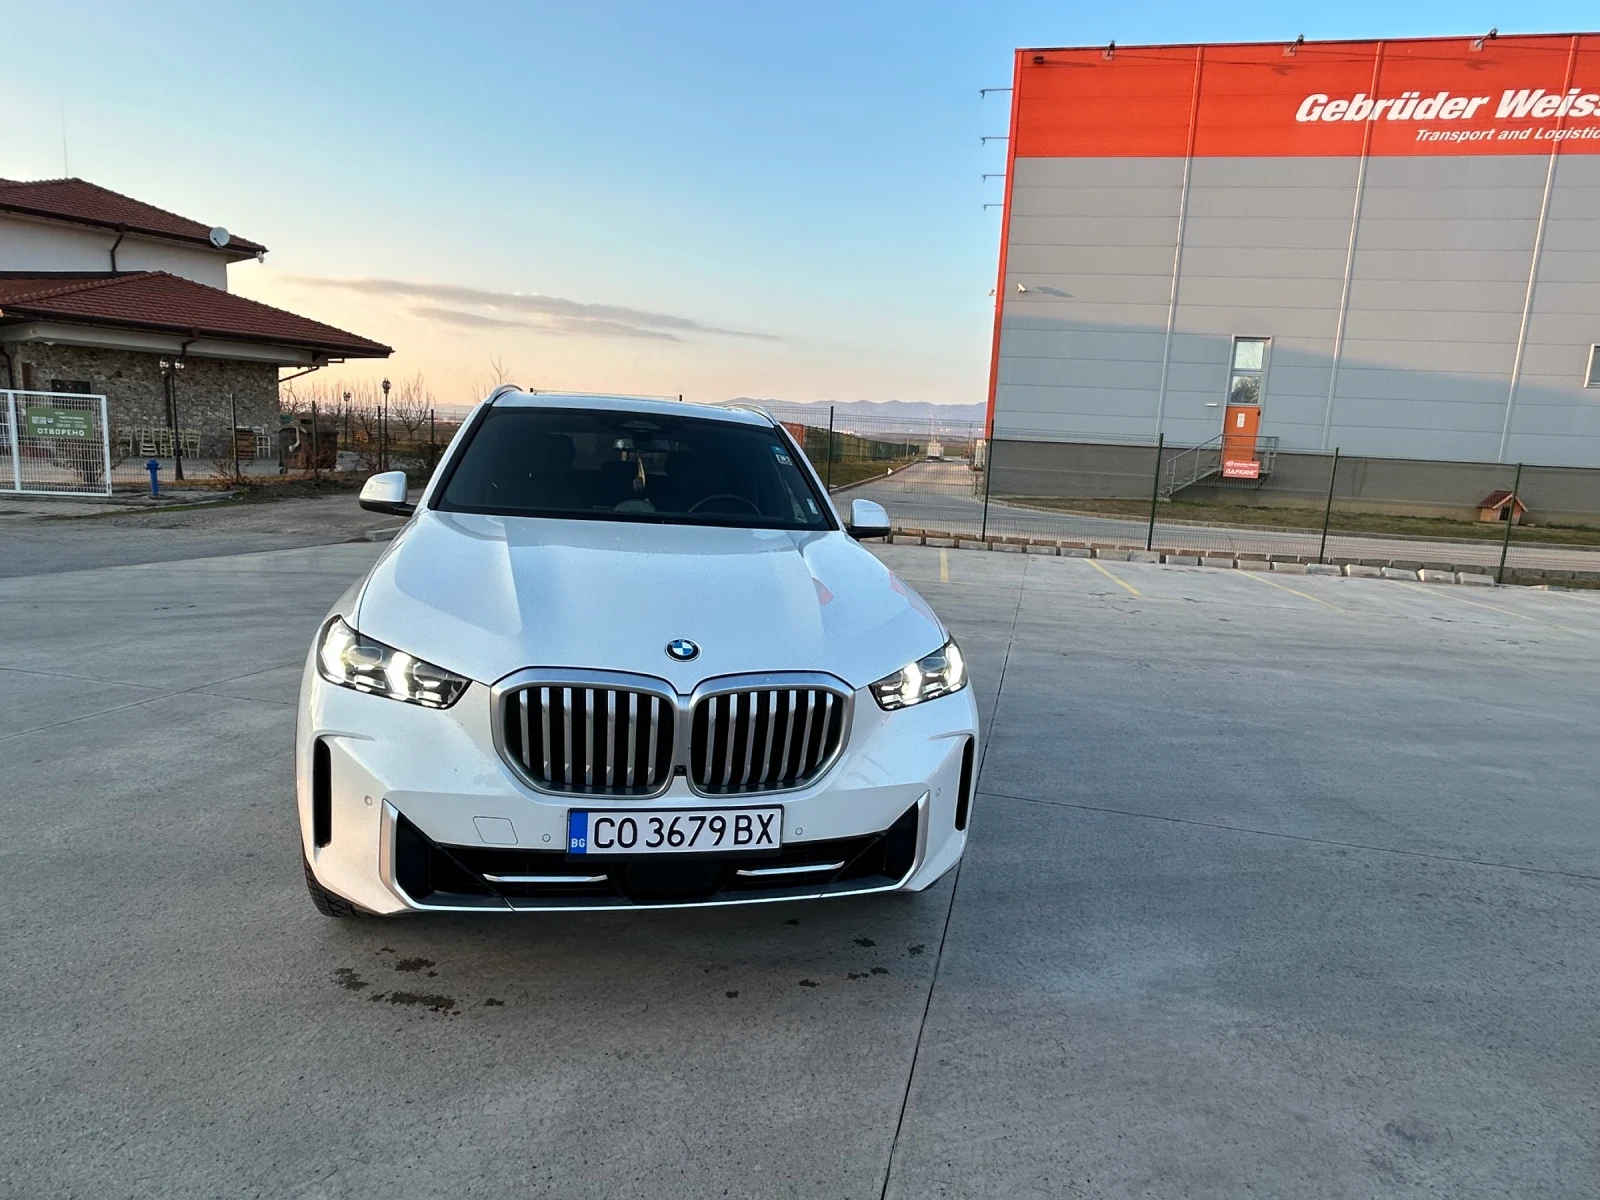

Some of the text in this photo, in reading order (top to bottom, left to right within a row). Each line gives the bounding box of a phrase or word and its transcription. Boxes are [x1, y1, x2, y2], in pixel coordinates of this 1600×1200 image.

[1295, 87, 1600, 122] Gebrüder Weis
[1415, 128, 1495, 142] Transport
[1497, 127, 1533, 140] and
[37, 427, 85, 436] ОТВОРЕНО
[1225, 468, 1257, 476] ПАРКИНГ
[645, 815, 727, 848] 3679
[733, 813, 775, 846] BX
[571, 837, 586, 849] BG
